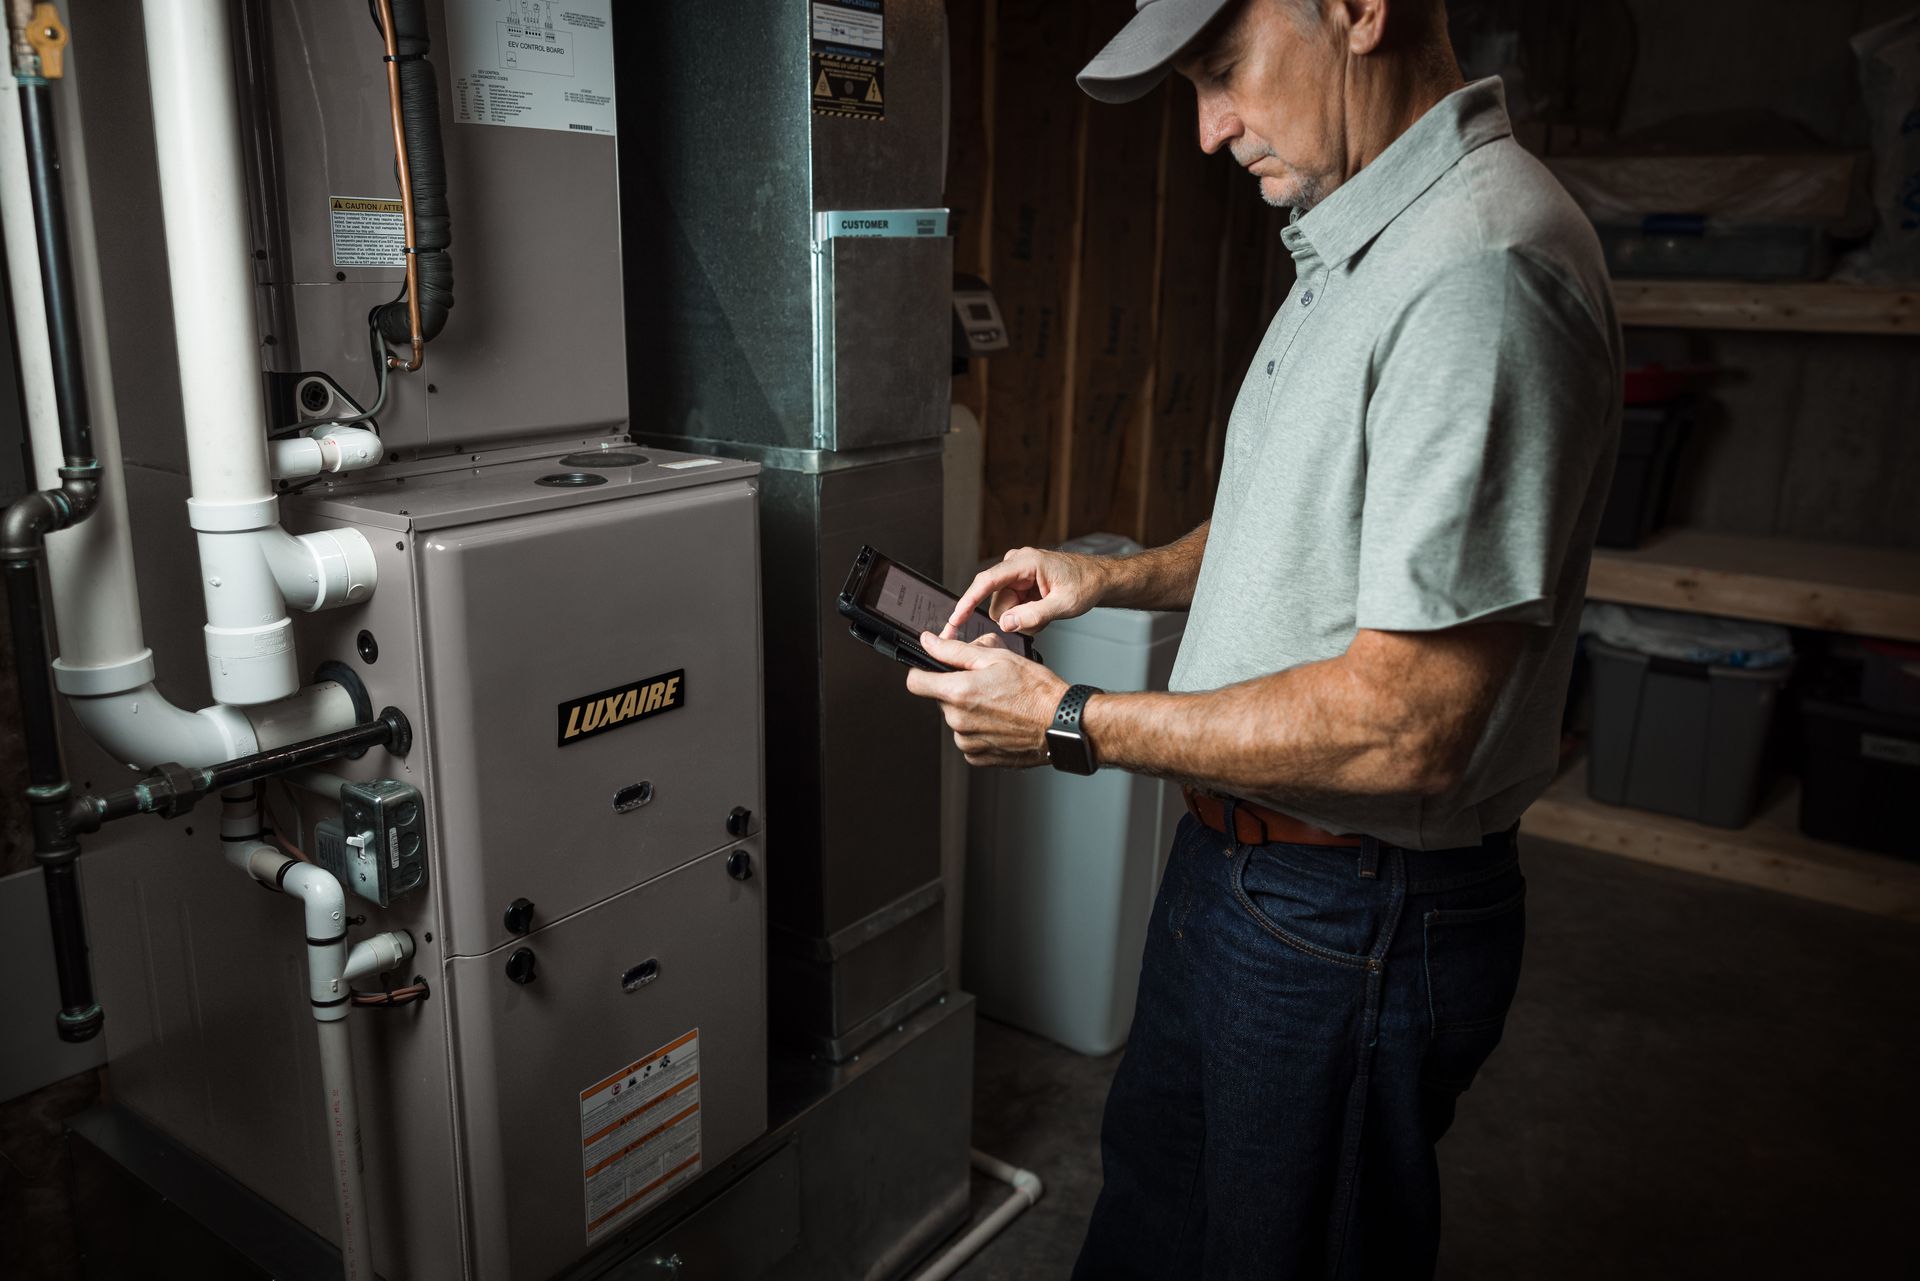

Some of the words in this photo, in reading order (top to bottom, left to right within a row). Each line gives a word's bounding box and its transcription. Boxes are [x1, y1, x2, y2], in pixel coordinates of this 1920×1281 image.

[520, 42, 545, 52] CONTROL
[546, 46, 565, 55] BOARD
[841, 219, 889, 229] CUSTOMER
[564, 676, 681, 739] LUXAIRE
